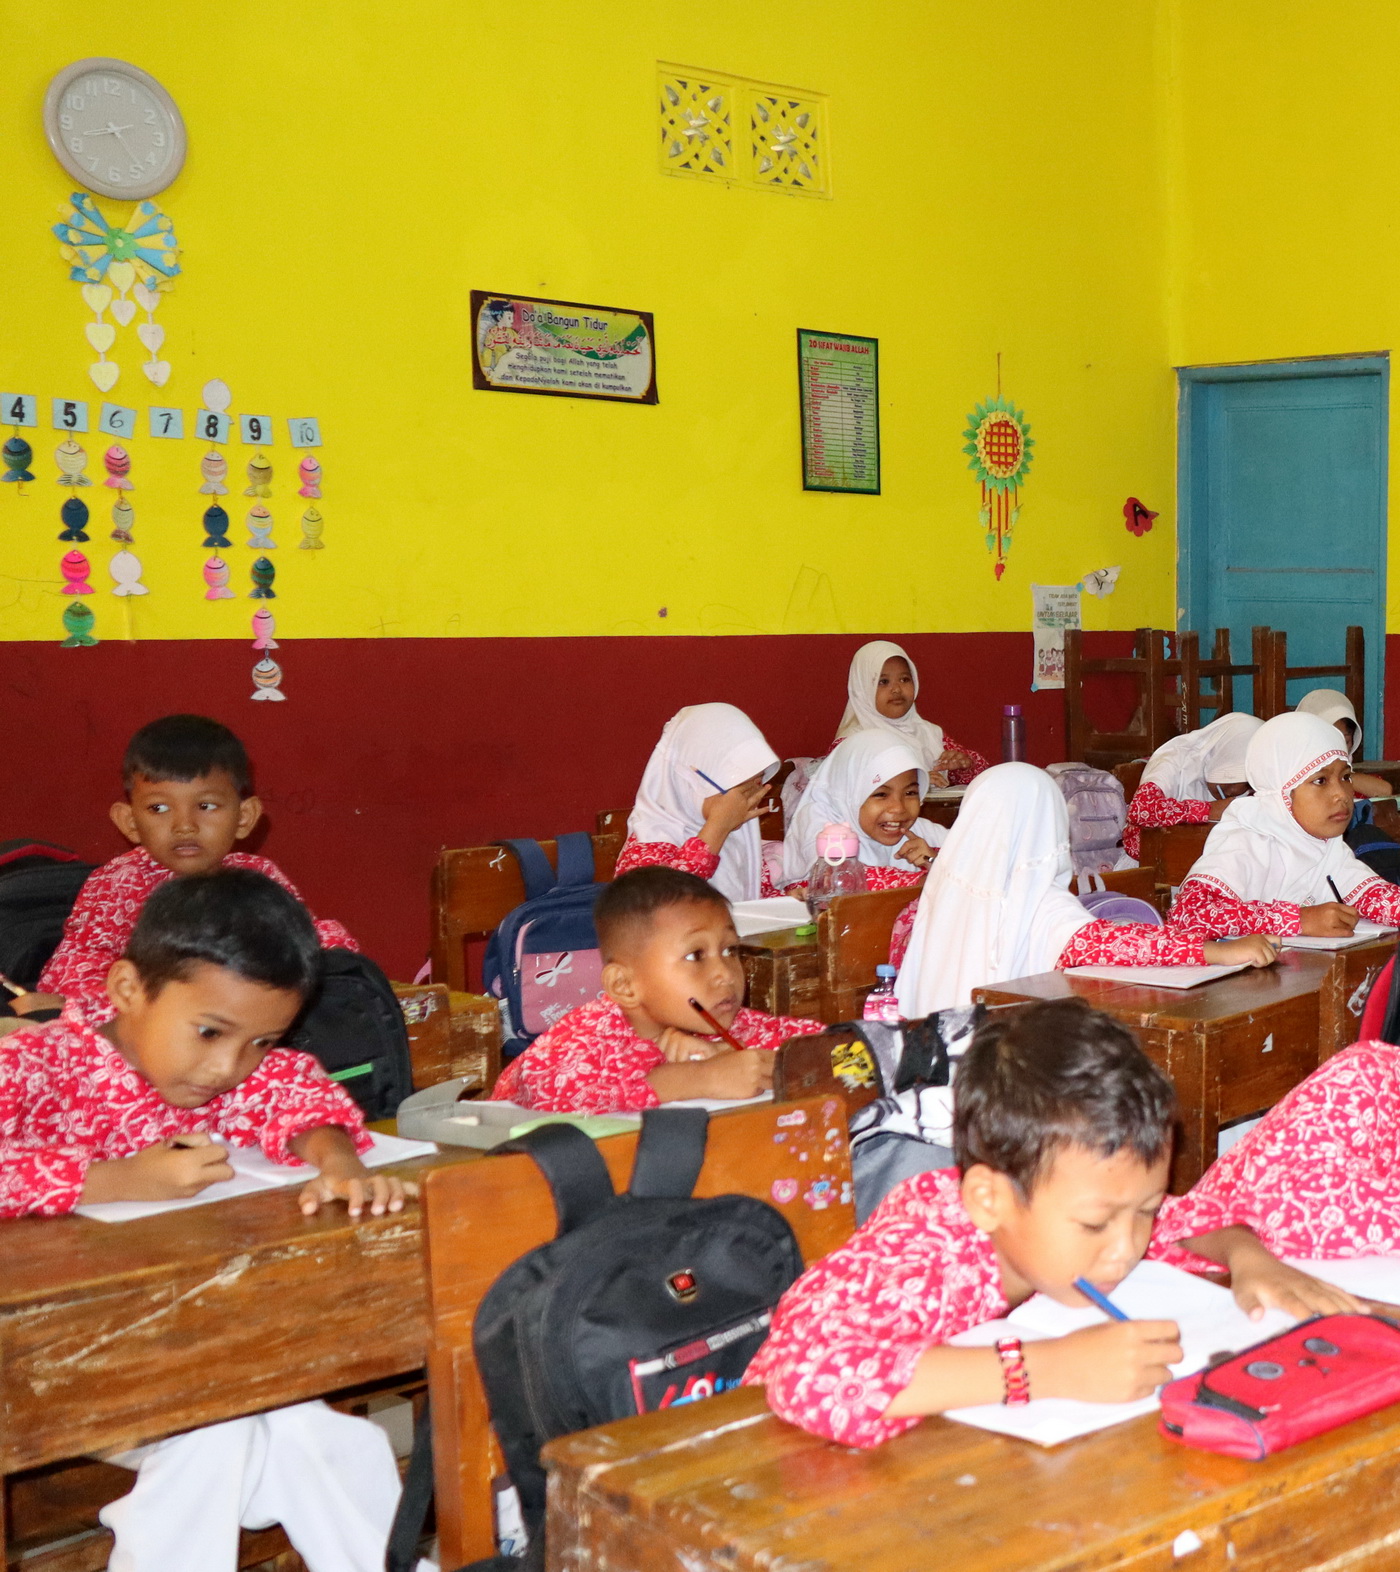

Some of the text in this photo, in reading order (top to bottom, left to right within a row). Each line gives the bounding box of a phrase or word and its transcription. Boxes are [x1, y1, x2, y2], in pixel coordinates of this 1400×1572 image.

[86, 81, 98, 97] 11
[103, 79, 120, 97] 12
[130, 89, 136, 104] 1
[66, 94, 84, 111] 10
[61, 114, 73, 130] 9
[144, 109, 156, 126] 2
[71, 137, 82, 154] 8
[152, 132, 165, 147] 3
[88, 156, 100, 171] 7
[145, 151, 157, 166] 4
[109, 167, 120, 181] 6
[129, 164, 144, 179] 5
[522, 309, 608, 331] Do'a Bangun Tidur
[809, 339, 817, 348] 20
[10, 396, 26, 423] 4
[63, 402, 77, 428] 5
[109, 410, 124, 429] 6
[159, 412, 173, 434] 7
[205, 414, 218, 438] 8
[249, 417, 262, 441] 9
[299, 422, 316, 444] 10
